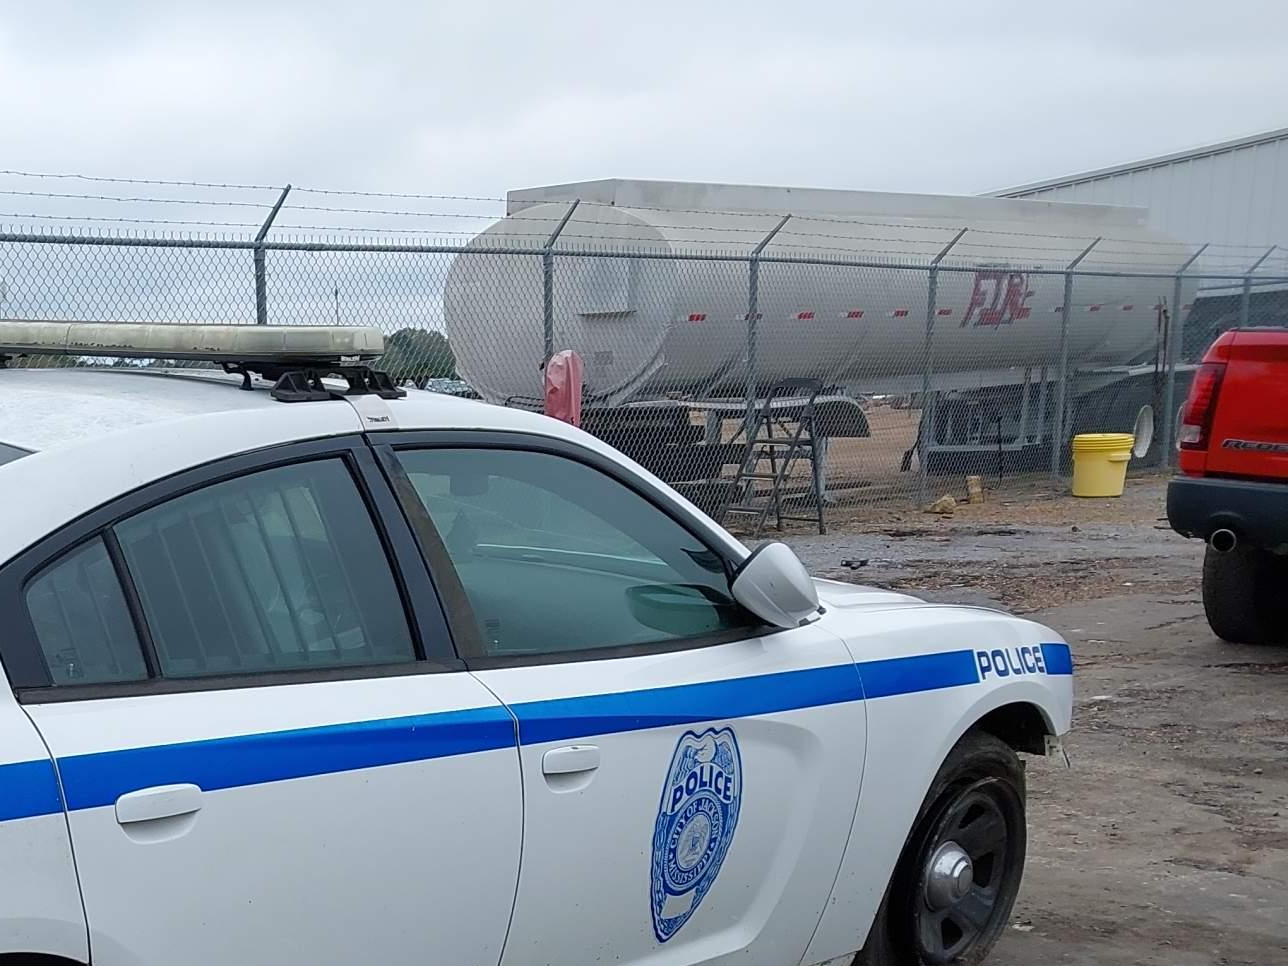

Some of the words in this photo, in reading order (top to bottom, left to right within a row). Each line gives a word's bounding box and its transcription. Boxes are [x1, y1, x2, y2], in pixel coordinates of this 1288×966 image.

[976, 646, 1046, 680] POLICE
[671, 764, 733, 810] POLICE
[670, 813, 687, 849] CITY
[686, 800, 698, 815] OF
[698, 798, 720, 838] JACKSON
[668, 848, 715, 884] MISSISSIPPI
